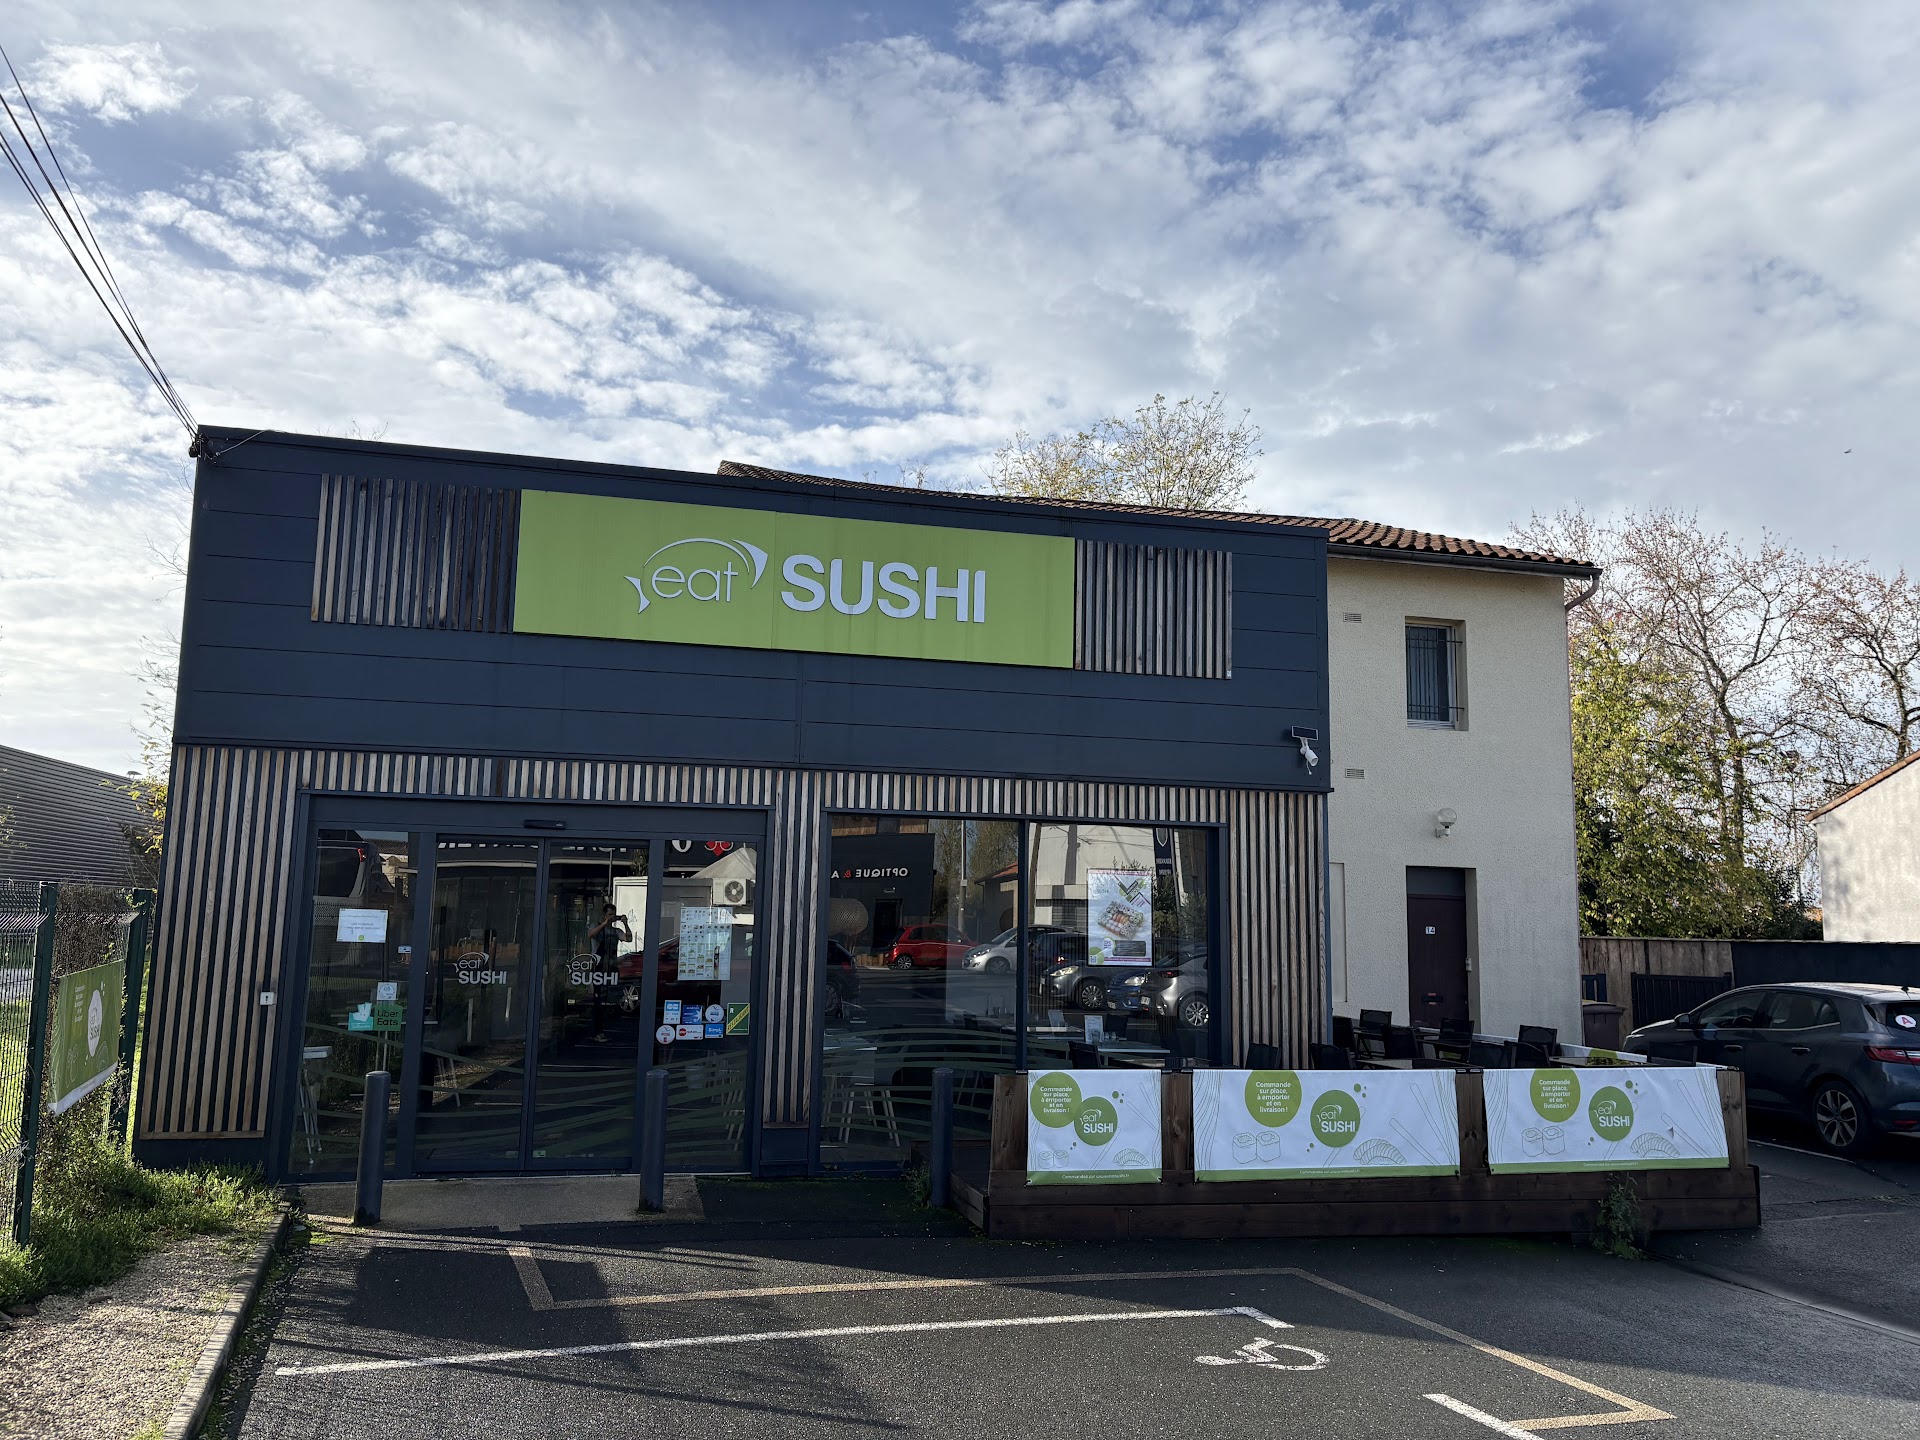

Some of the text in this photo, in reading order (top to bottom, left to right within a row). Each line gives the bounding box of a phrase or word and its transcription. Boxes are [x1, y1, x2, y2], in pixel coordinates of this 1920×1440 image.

[651, 554, 986, 624] eat SUSHI
[459, 958, 481, 969] eat
[571, 959, 594, 970] eat
[458, 970, 507, 985] SUSHI
[571, 971, 618, 986] SUSHI
[377, 1010, 399, 1018] Uber
[377, 1018, 399, 1026] Eats
[1901, 1017, 1913, 1025] A
[1321, 1110, 1337, 1119] eat
[1598, 1106, 1613, 1115] eat
[1083, 1114, 1097, 1122] eat
[1598, 1116, 1630, 1127] SUSHI
[1083, 1123, 1114, 1134] SUSHI
[1321, 1121, 1356, 1133] SUSHI
